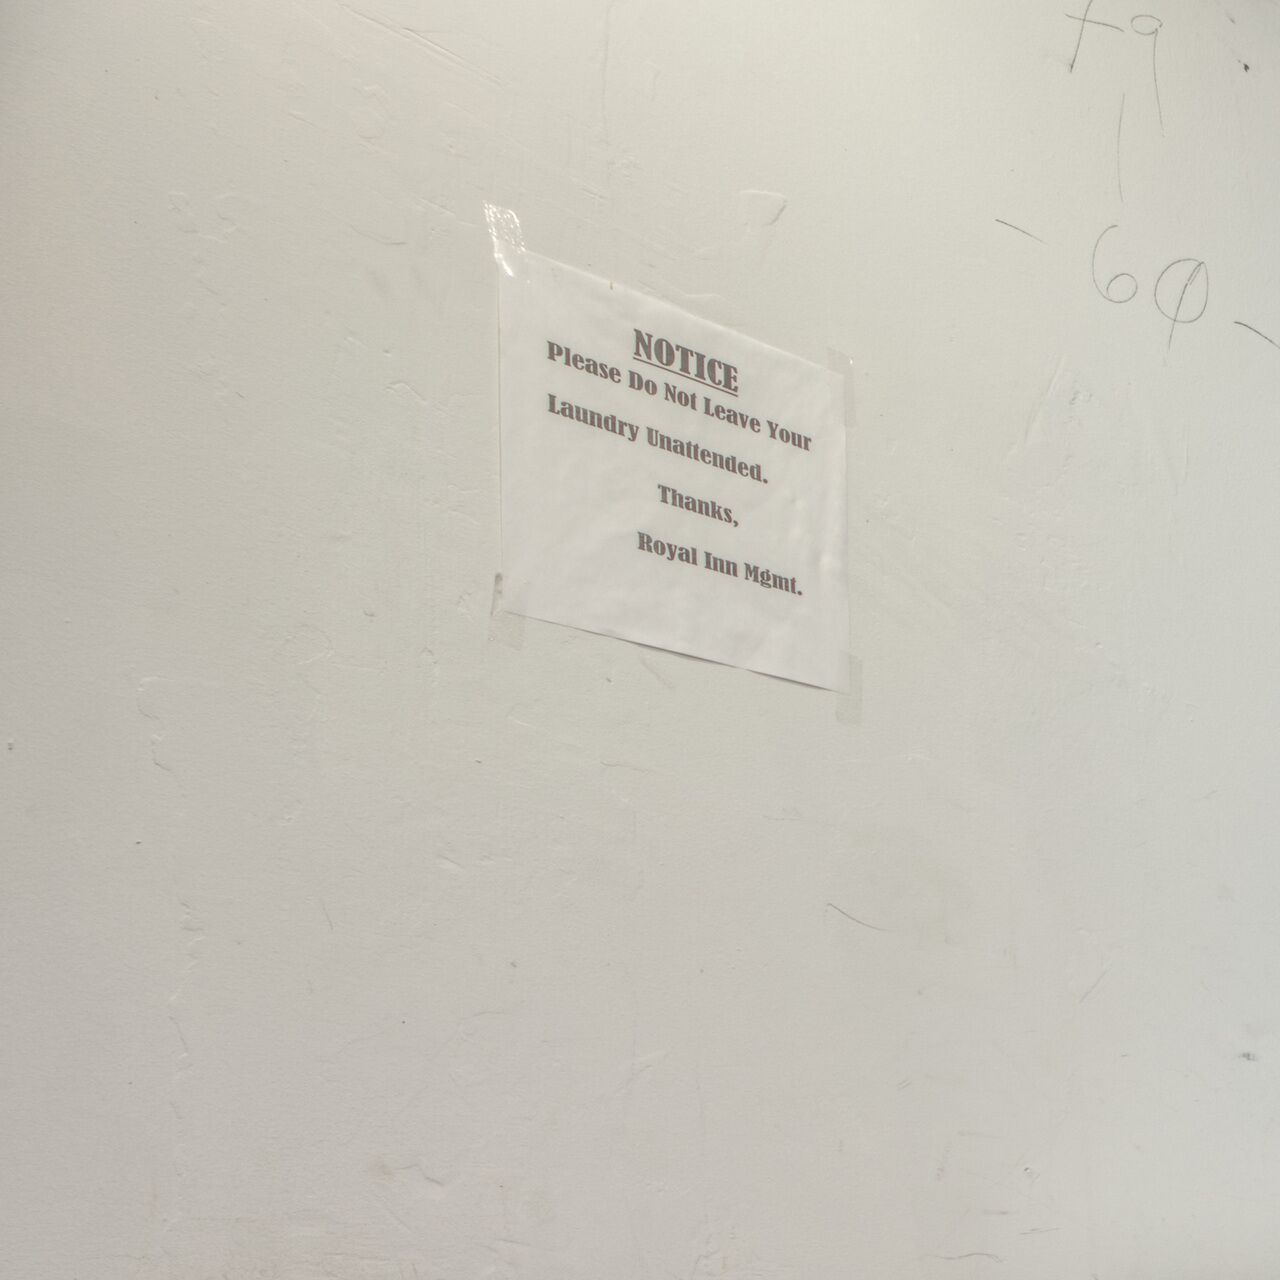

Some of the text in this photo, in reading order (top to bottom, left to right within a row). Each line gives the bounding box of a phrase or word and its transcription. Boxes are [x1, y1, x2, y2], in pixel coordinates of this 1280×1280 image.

[633, 329, 738, 393] NOTICE
[547, 340, 812, 451] Please Do Not Leave Your
[548, 394, 768, 484] Laundry Unattended.
[658, 484, 739, 528] Thanks,
[638, 531, 803, 596] Royal Inn Mgmt.
